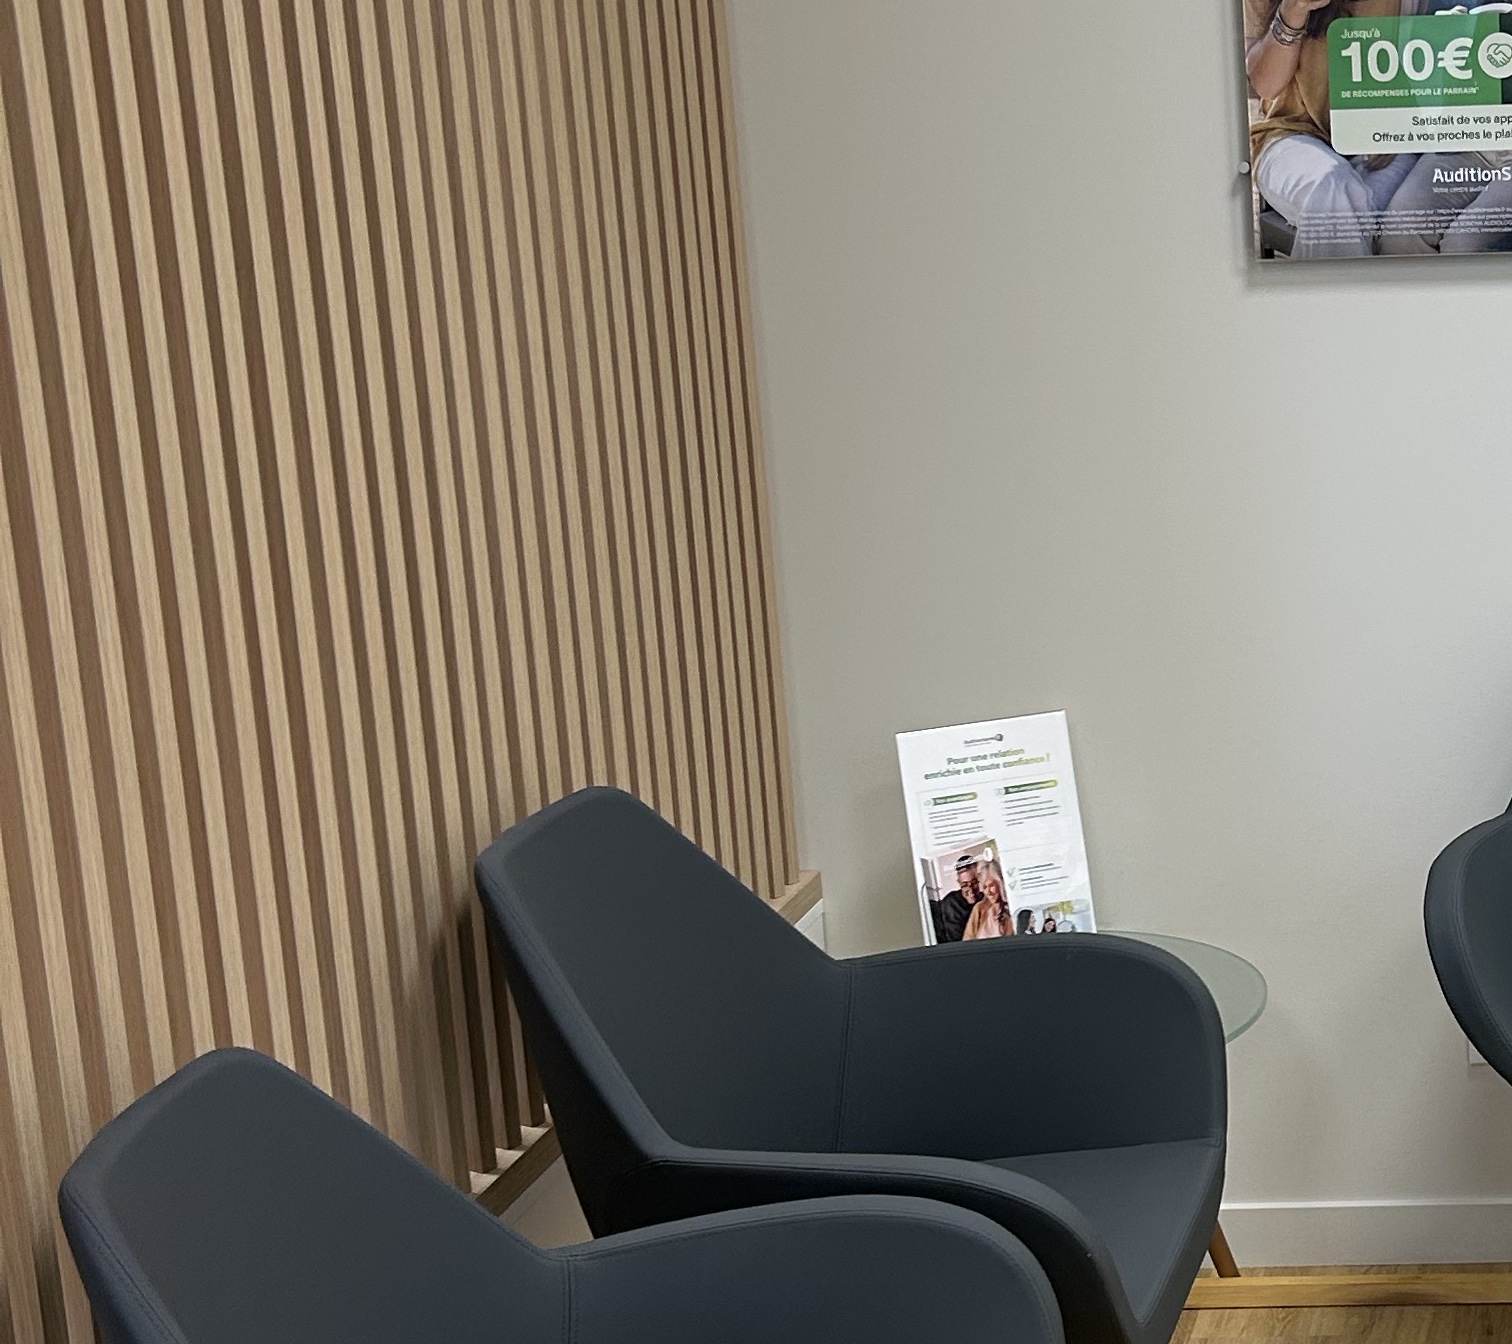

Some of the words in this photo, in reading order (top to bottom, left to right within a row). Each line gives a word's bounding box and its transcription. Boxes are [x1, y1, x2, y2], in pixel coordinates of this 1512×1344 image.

[1340, 28, 1381, 40] Jusqu'à
[1340, 37, 1474, 83] 100€
[1410, 87, 1432, 96] POUR
[1411, 115, 1455, 126] Satisfait
[1456, 115, 1470, 125] de
[1472, 116, 1492, 125] vos
[1372, 131, 1405, 143] Offrez
[1408, 131, 1414, 142] à
[1416, 132, 1435, 142] vos
[1437, 129, 1480, 143] proches
[1483, 129, 1493, 139] le
